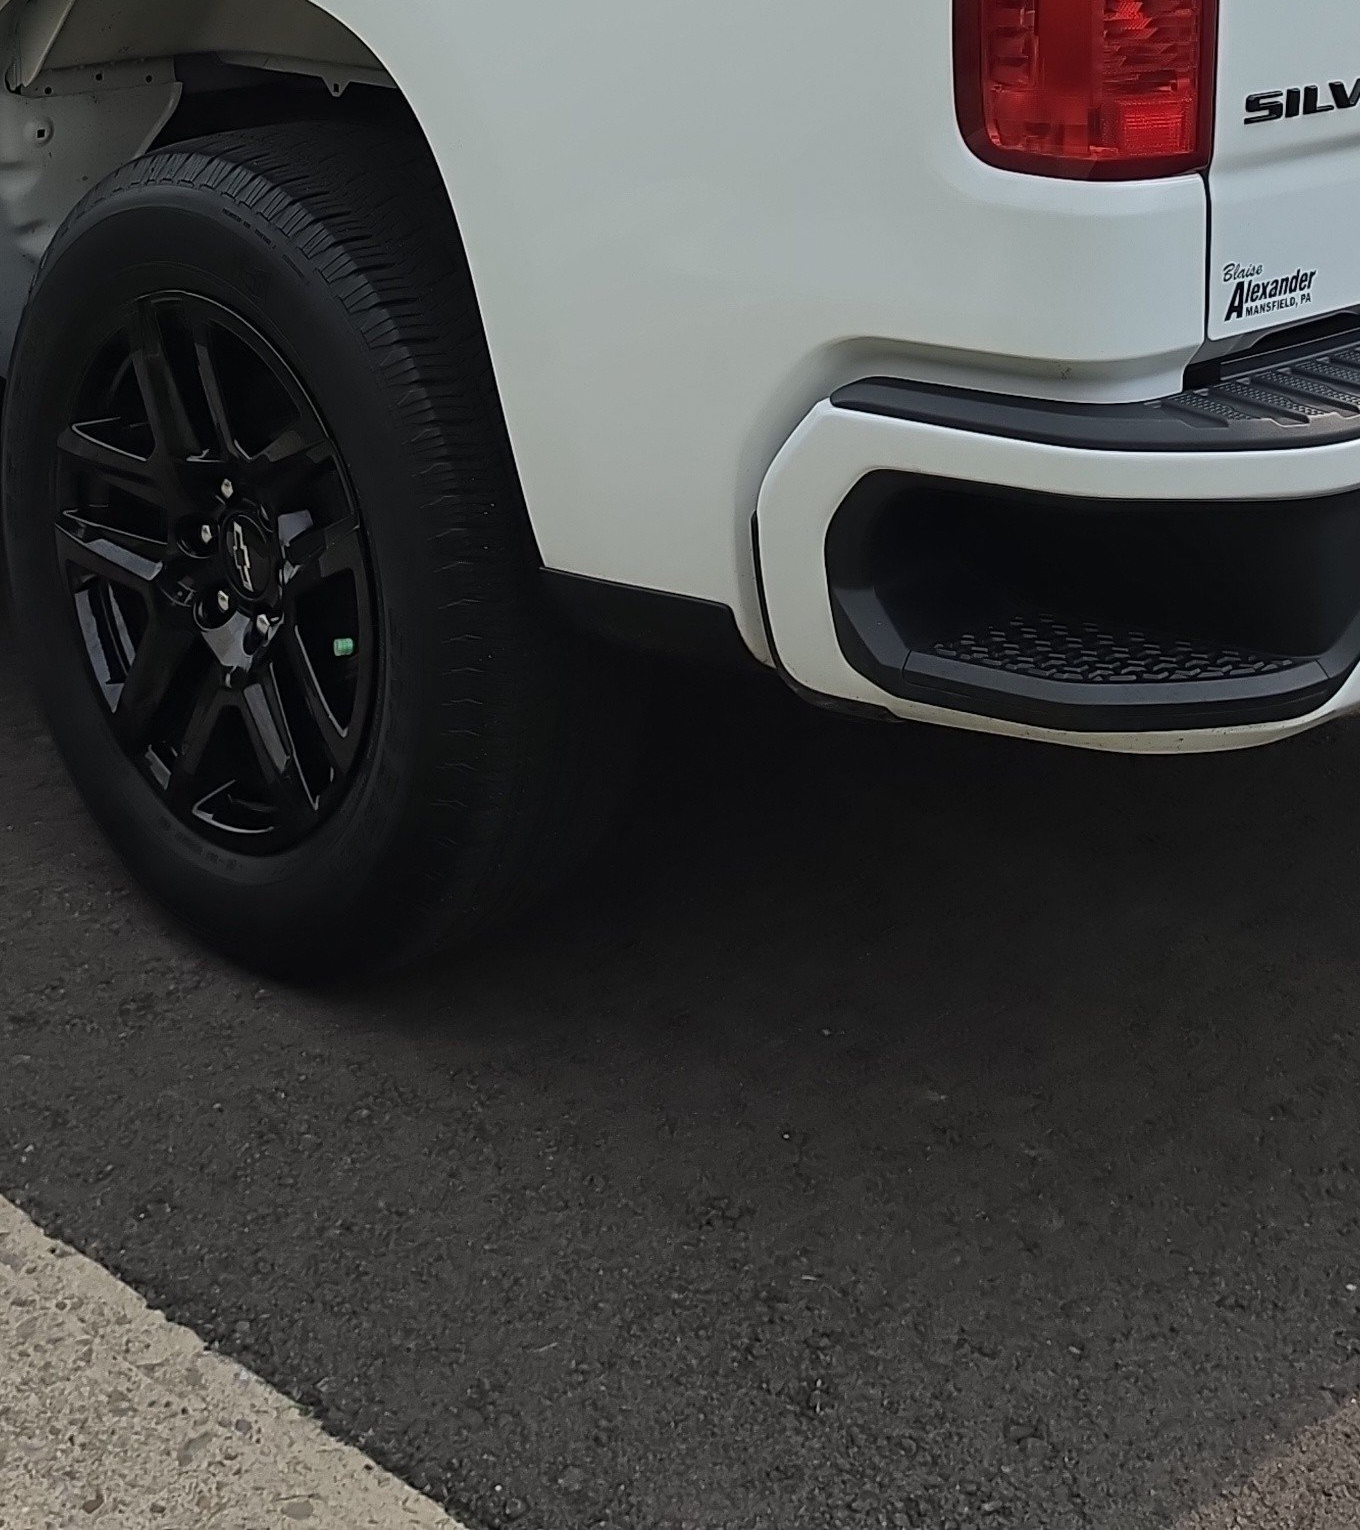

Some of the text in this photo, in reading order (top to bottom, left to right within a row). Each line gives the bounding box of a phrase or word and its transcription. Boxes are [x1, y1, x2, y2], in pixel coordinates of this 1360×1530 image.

[1223, 263, 1263, 282] Blaise
[1224, 268, 1317, 322] Alexander
[1300, 292, 1312, 305] PA
